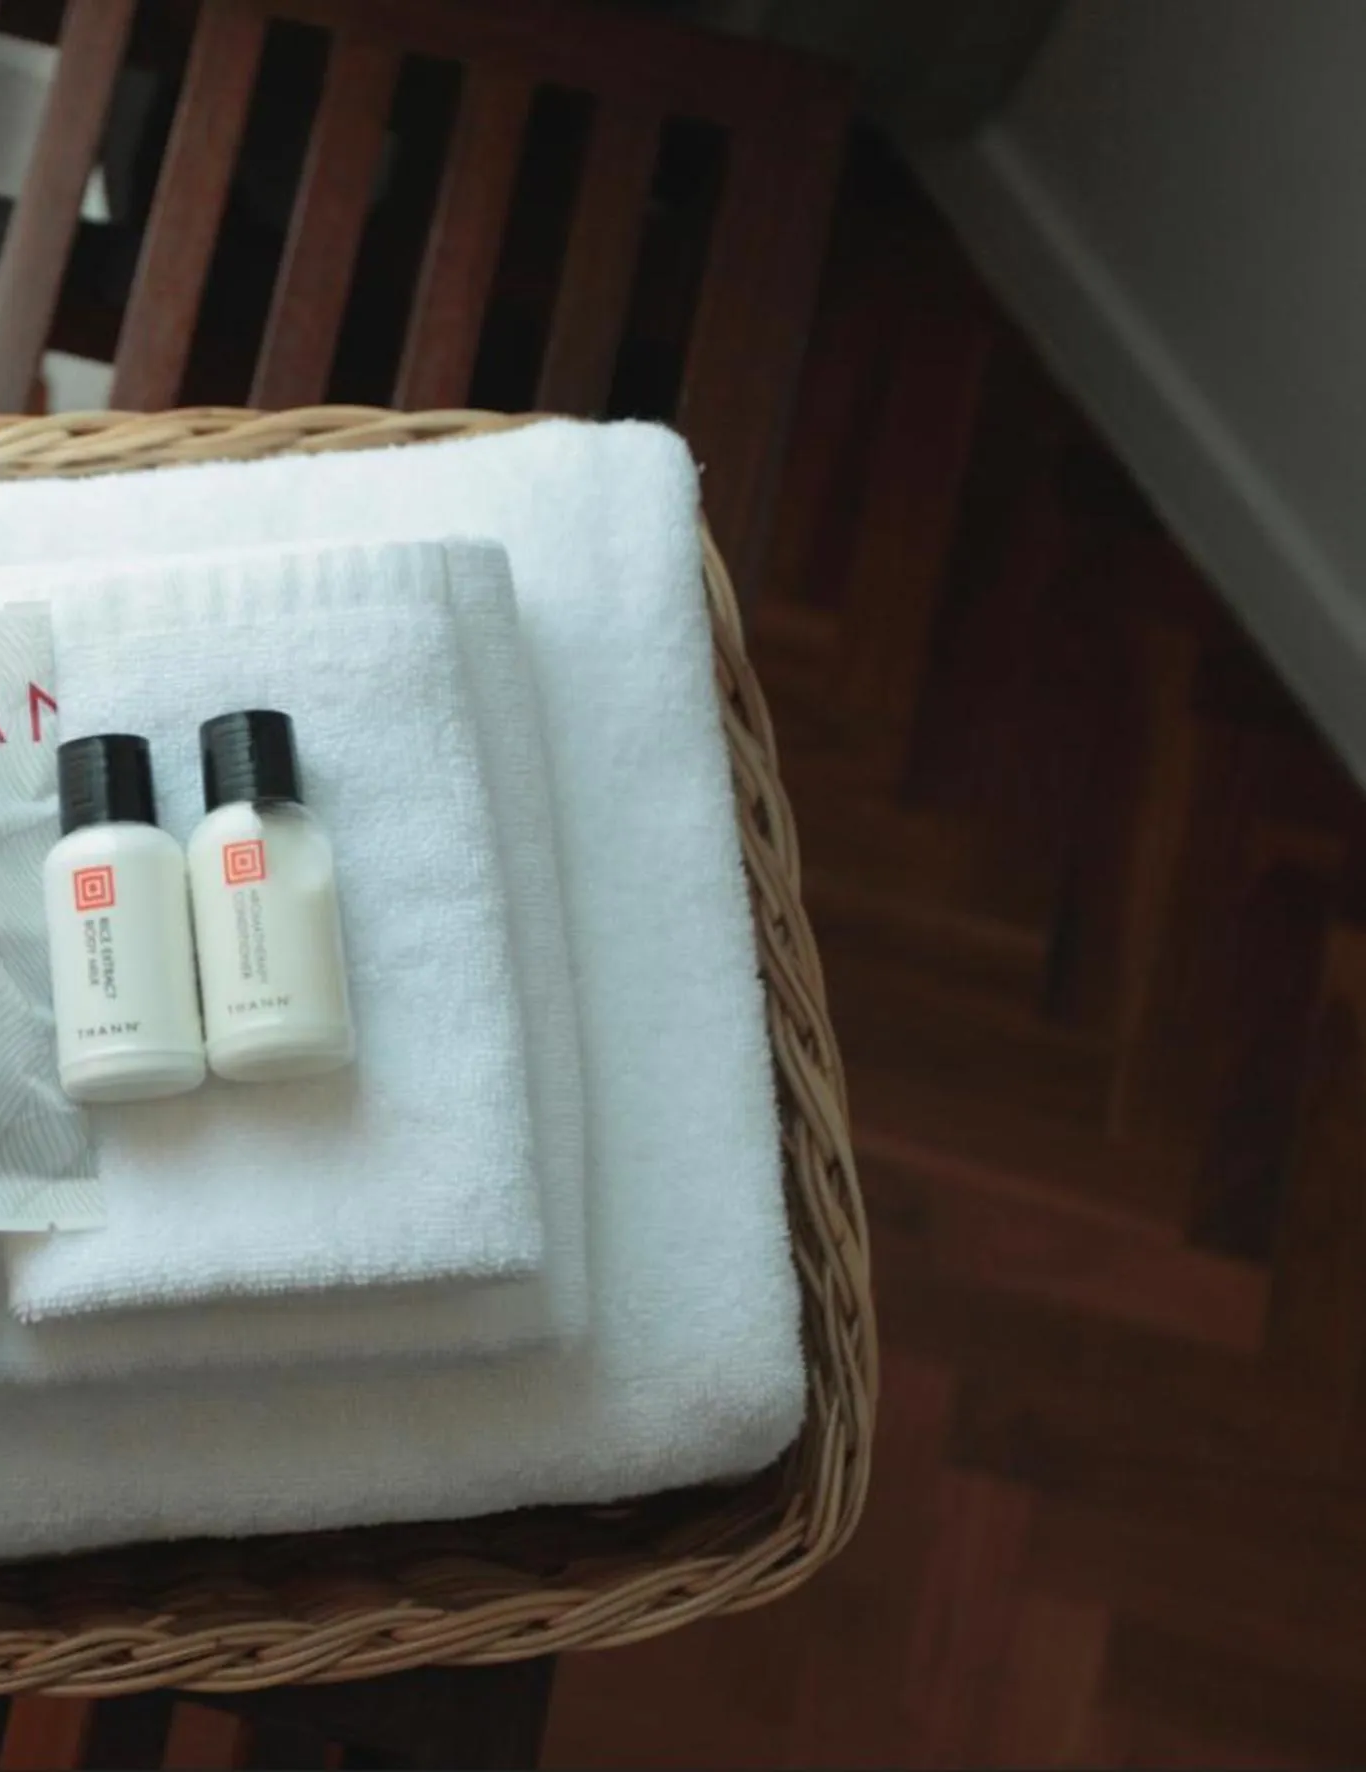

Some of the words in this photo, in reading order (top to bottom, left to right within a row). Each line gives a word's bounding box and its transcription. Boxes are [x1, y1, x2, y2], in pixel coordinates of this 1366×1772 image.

[85, 919, 97, 954] BODY
[99, 917, 112, 944] RICE
[101, 947, 117, 999] EXTRACT
[77, 1022, 141, 1040] THANN
